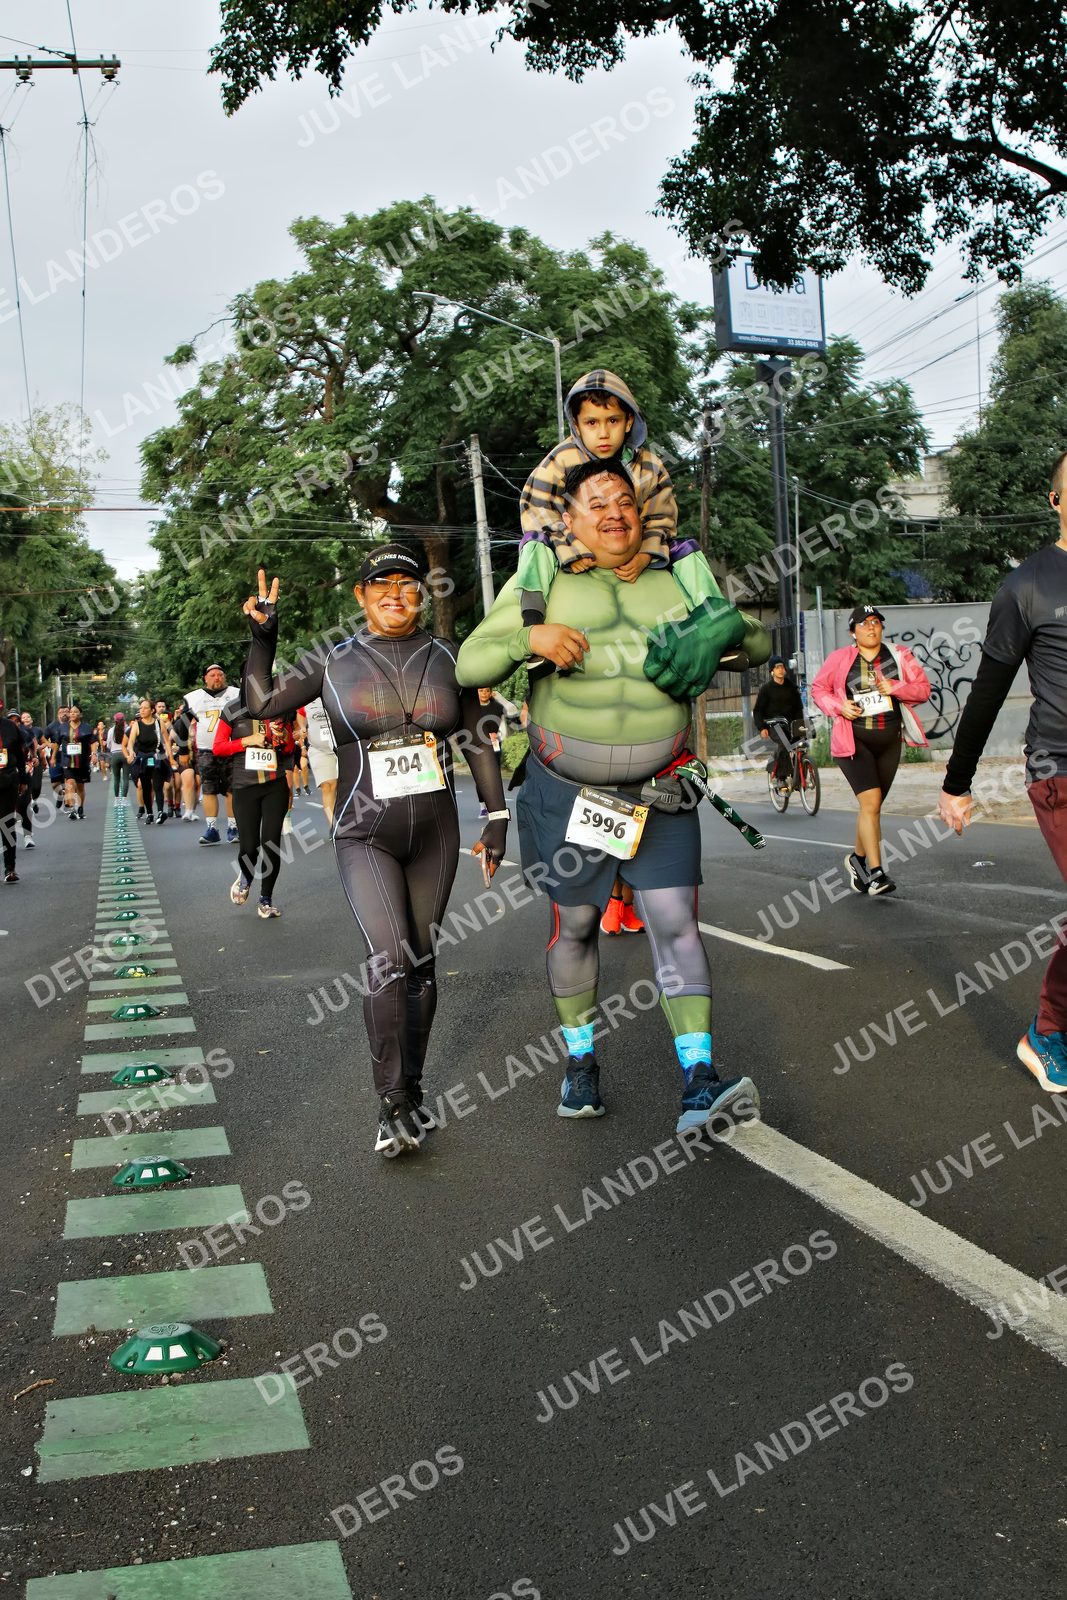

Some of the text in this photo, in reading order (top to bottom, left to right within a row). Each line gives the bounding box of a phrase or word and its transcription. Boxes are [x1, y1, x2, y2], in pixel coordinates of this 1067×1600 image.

[205, 709, 220, 733] 7
[250, 751, 272, 761] 3160
[384, 752, 422, 777] 204
[580, 807, 627, 839] 5996
